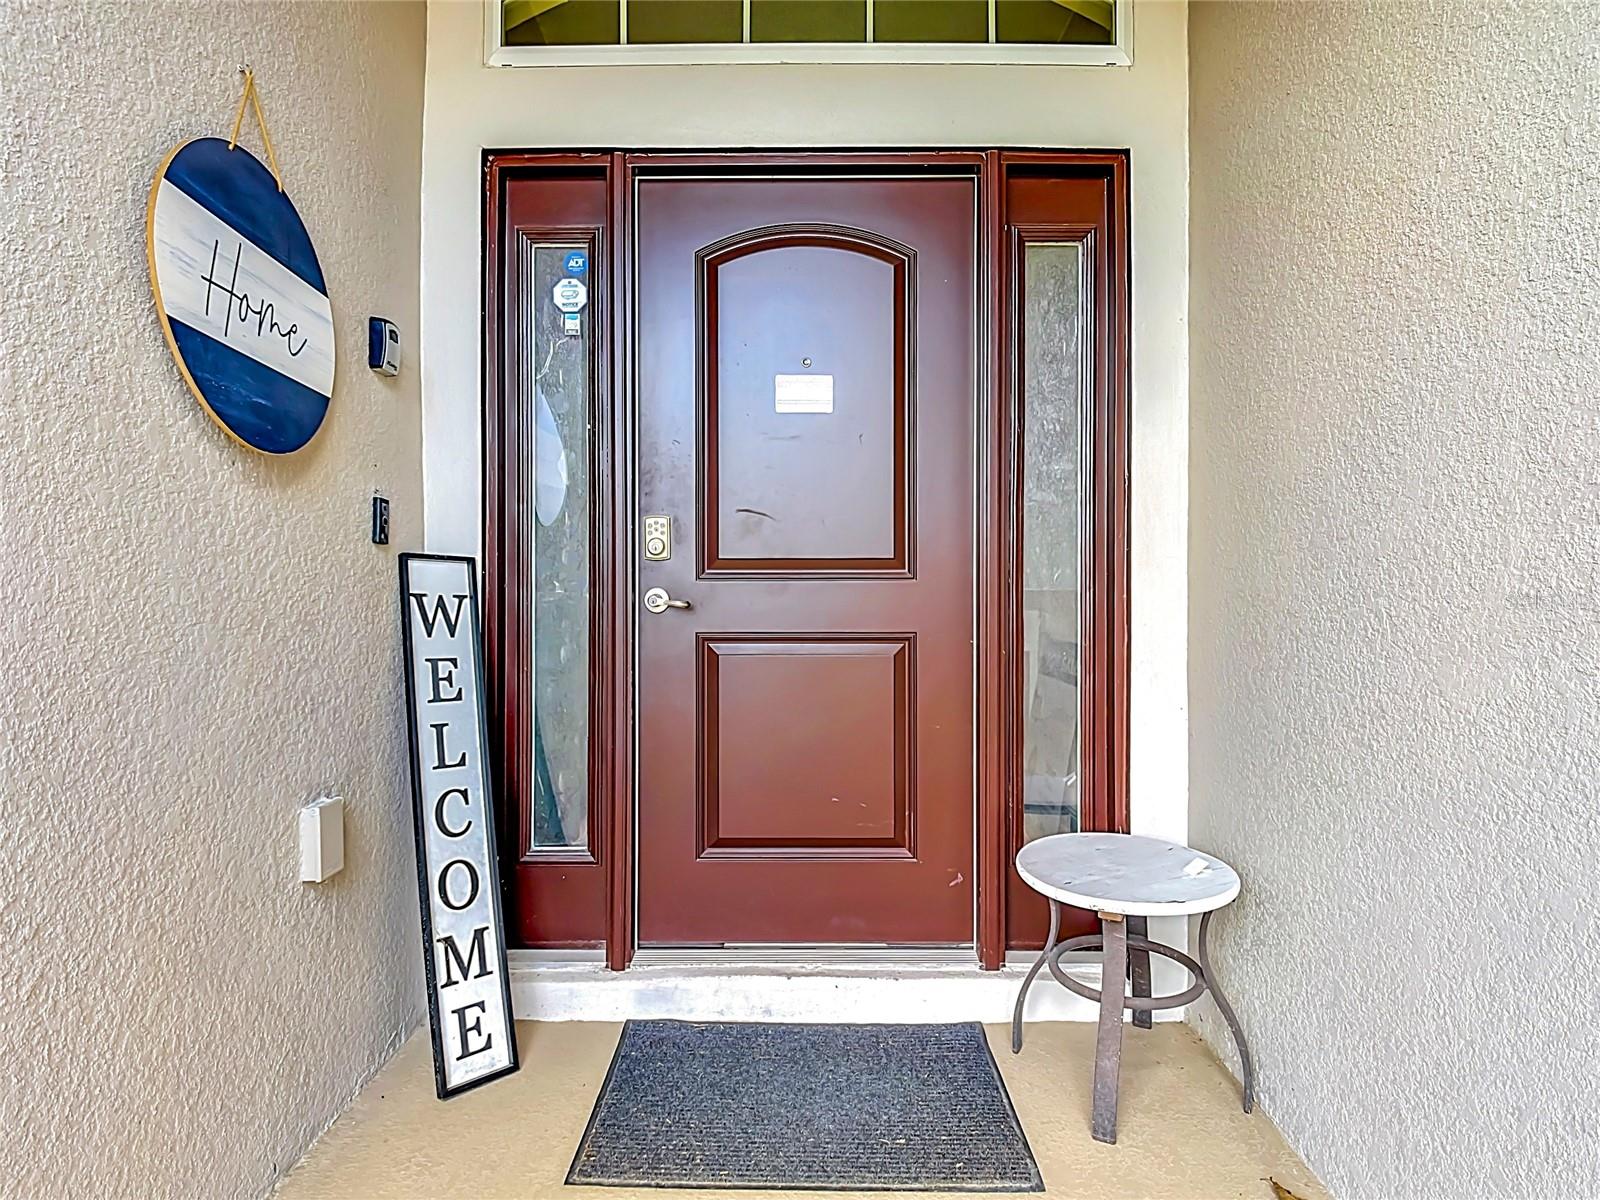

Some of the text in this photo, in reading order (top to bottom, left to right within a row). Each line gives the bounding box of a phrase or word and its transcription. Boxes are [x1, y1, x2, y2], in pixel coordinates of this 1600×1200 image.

[201, 239, 308, 357] Home
[568, 258, 585, 267] ADT
[408, 592, 494, 1061] WELCOME
